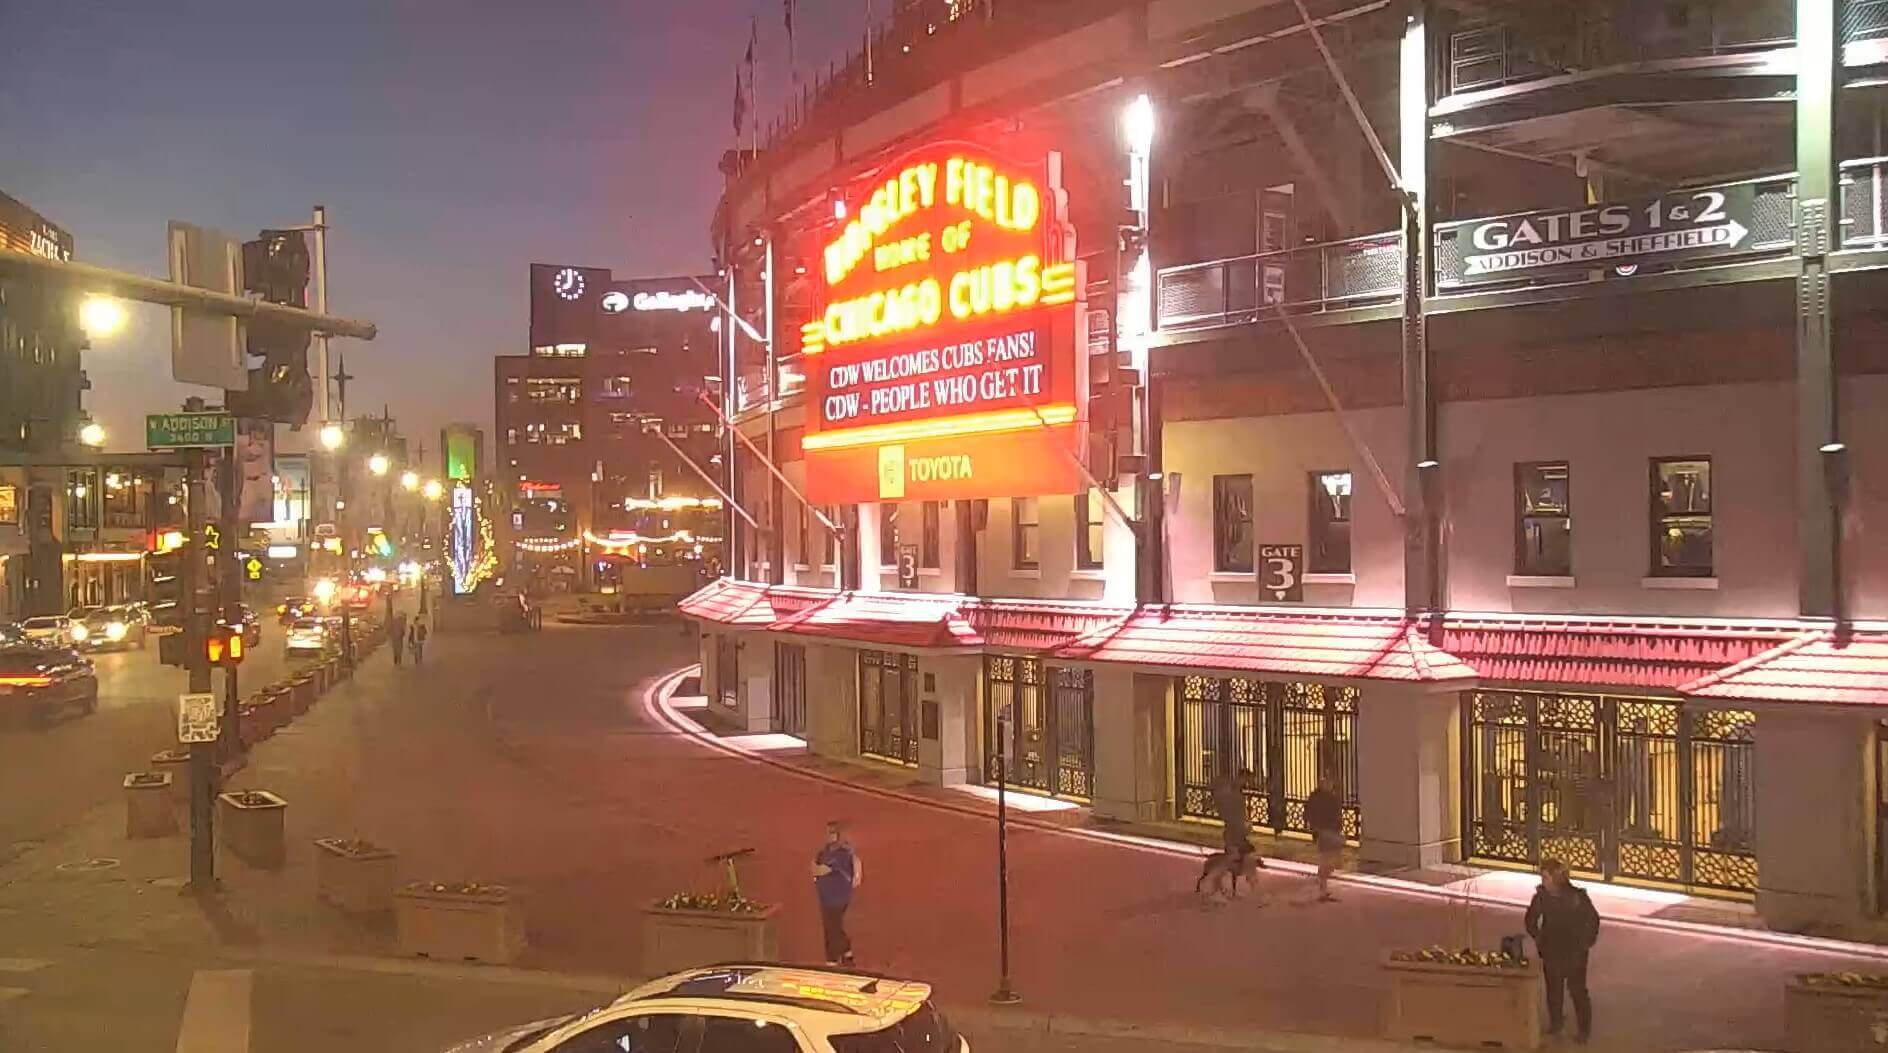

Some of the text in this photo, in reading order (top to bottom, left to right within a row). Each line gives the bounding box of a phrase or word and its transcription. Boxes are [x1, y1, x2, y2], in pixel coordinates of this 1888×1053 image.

[945, 156, 1039, 232] FIELD
[941, 219, 972, 253] OF
[1472, 192, 1726, 250] GATES 1 & 2
[1476, 226, 1730, 271] ADDISON & SHEFFIELD
[824, 255, 1042, 346] CHICAGO CUBS
[830, 331, 1035, 389] CDW WELCOMES CUBS FANS!
[825, 393, 861, 421] CDW
[871, 380, 931, 415] PEOPLE
[933, 373, 977, 408] WHO
[980, 367, 1019, 400] GET
[1023, 364, 1043, 395] IT
[162, 416, 218, 431] ADDISON
[909, 454, 973, 482] TOYOTA
[902, 555, 914, 578] 3
[1262, 546, 1301, 557] GATE
[1266, 558, 1294, 590] 3
